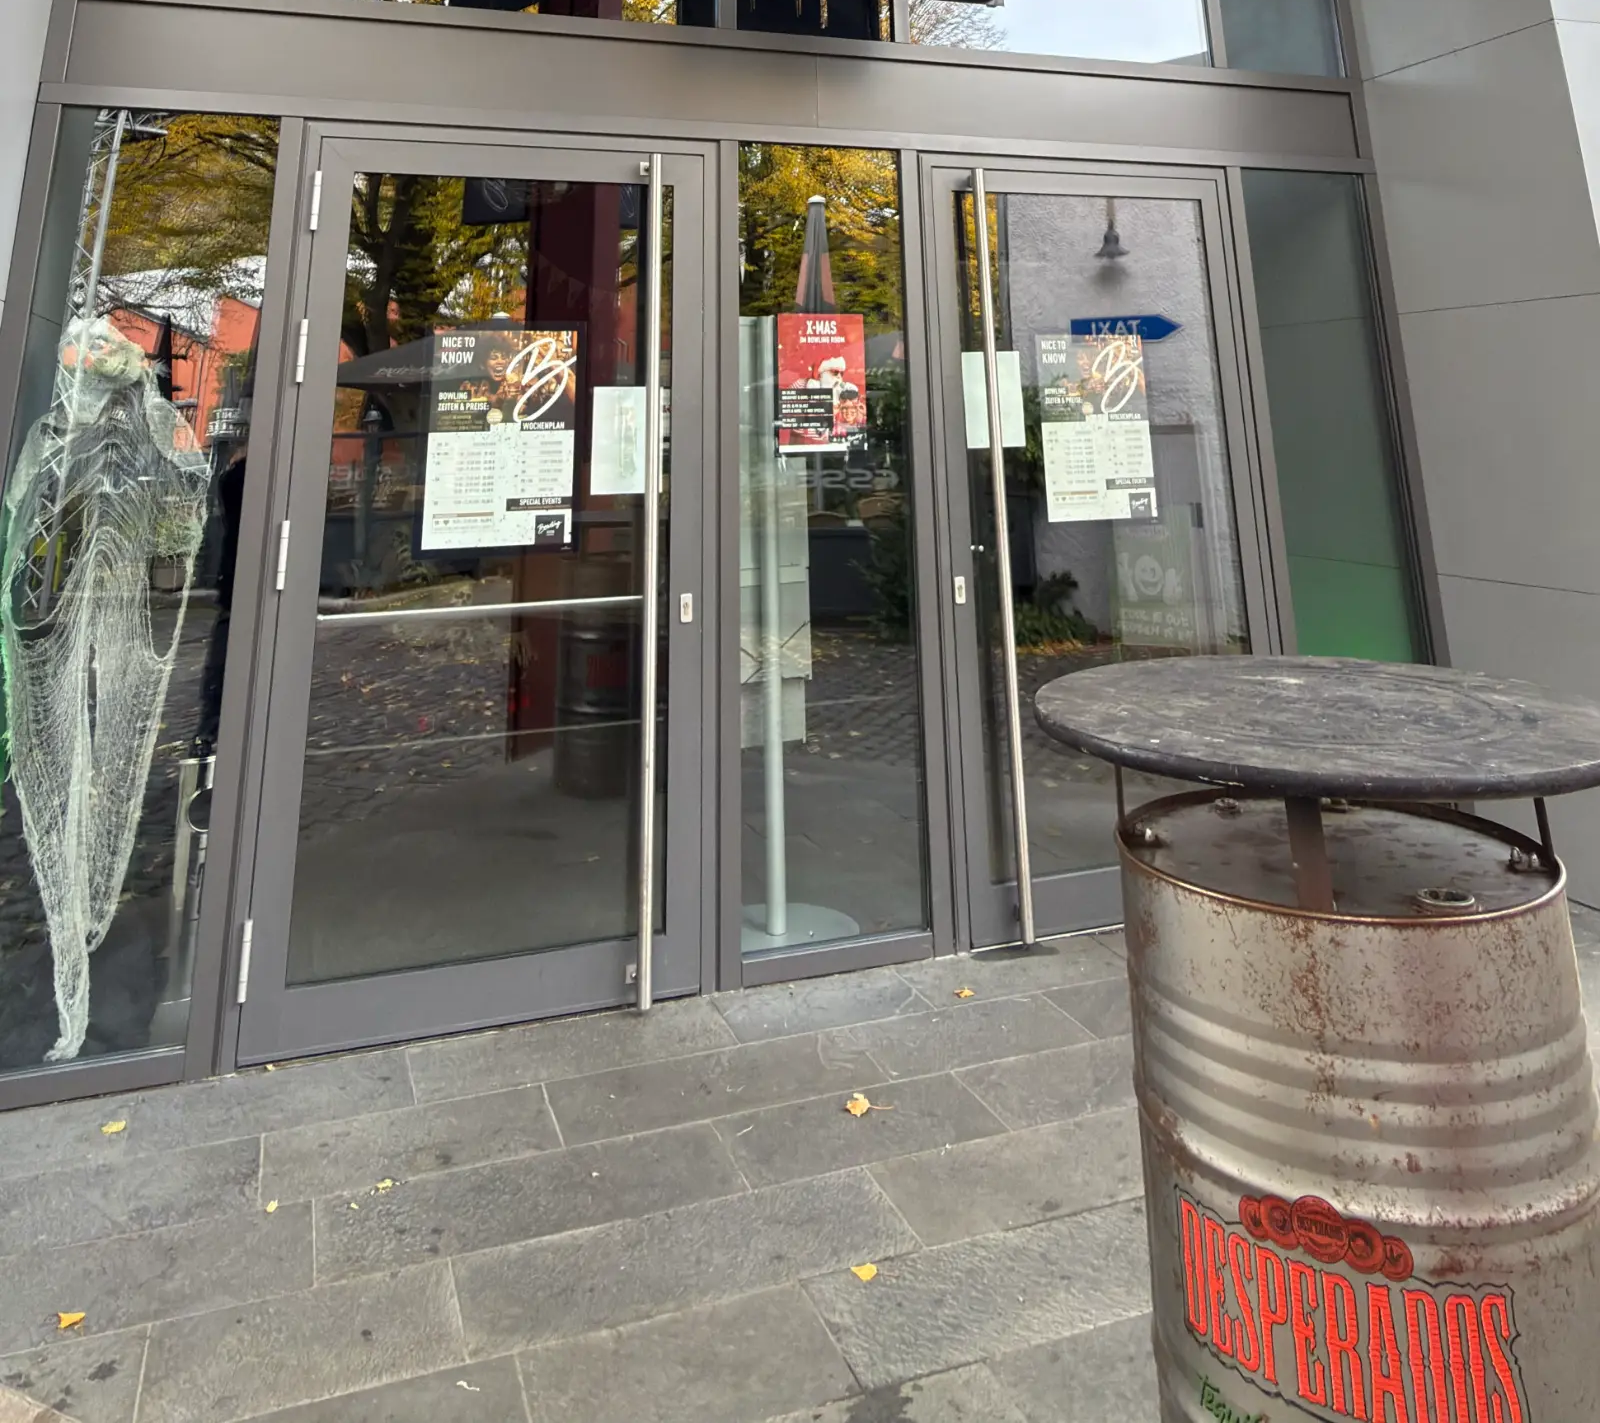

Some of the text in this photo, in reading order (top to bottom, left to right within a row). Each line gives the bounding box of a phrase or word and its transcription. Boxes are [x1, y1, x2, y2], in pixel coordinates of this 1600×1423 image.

[442, 337, 476, 348] NICE TO
[1041, 340, 1066, 350] NICE TO
[441, 352, 474, 364] KNOW
[1042, 354, 1067, 363] KNOW
[438, 392, 468, 400] BOWLING
[438, 403, 459, 412] ZEITEN
[466, 402, 490, 411] PREISE:
[522, 422, 565, 430] WOCHENPLAN
[520, 497, 562, 506] SPECIAL EVENTS
[1180, 1195, 1524, 1423] DESPERADOS
